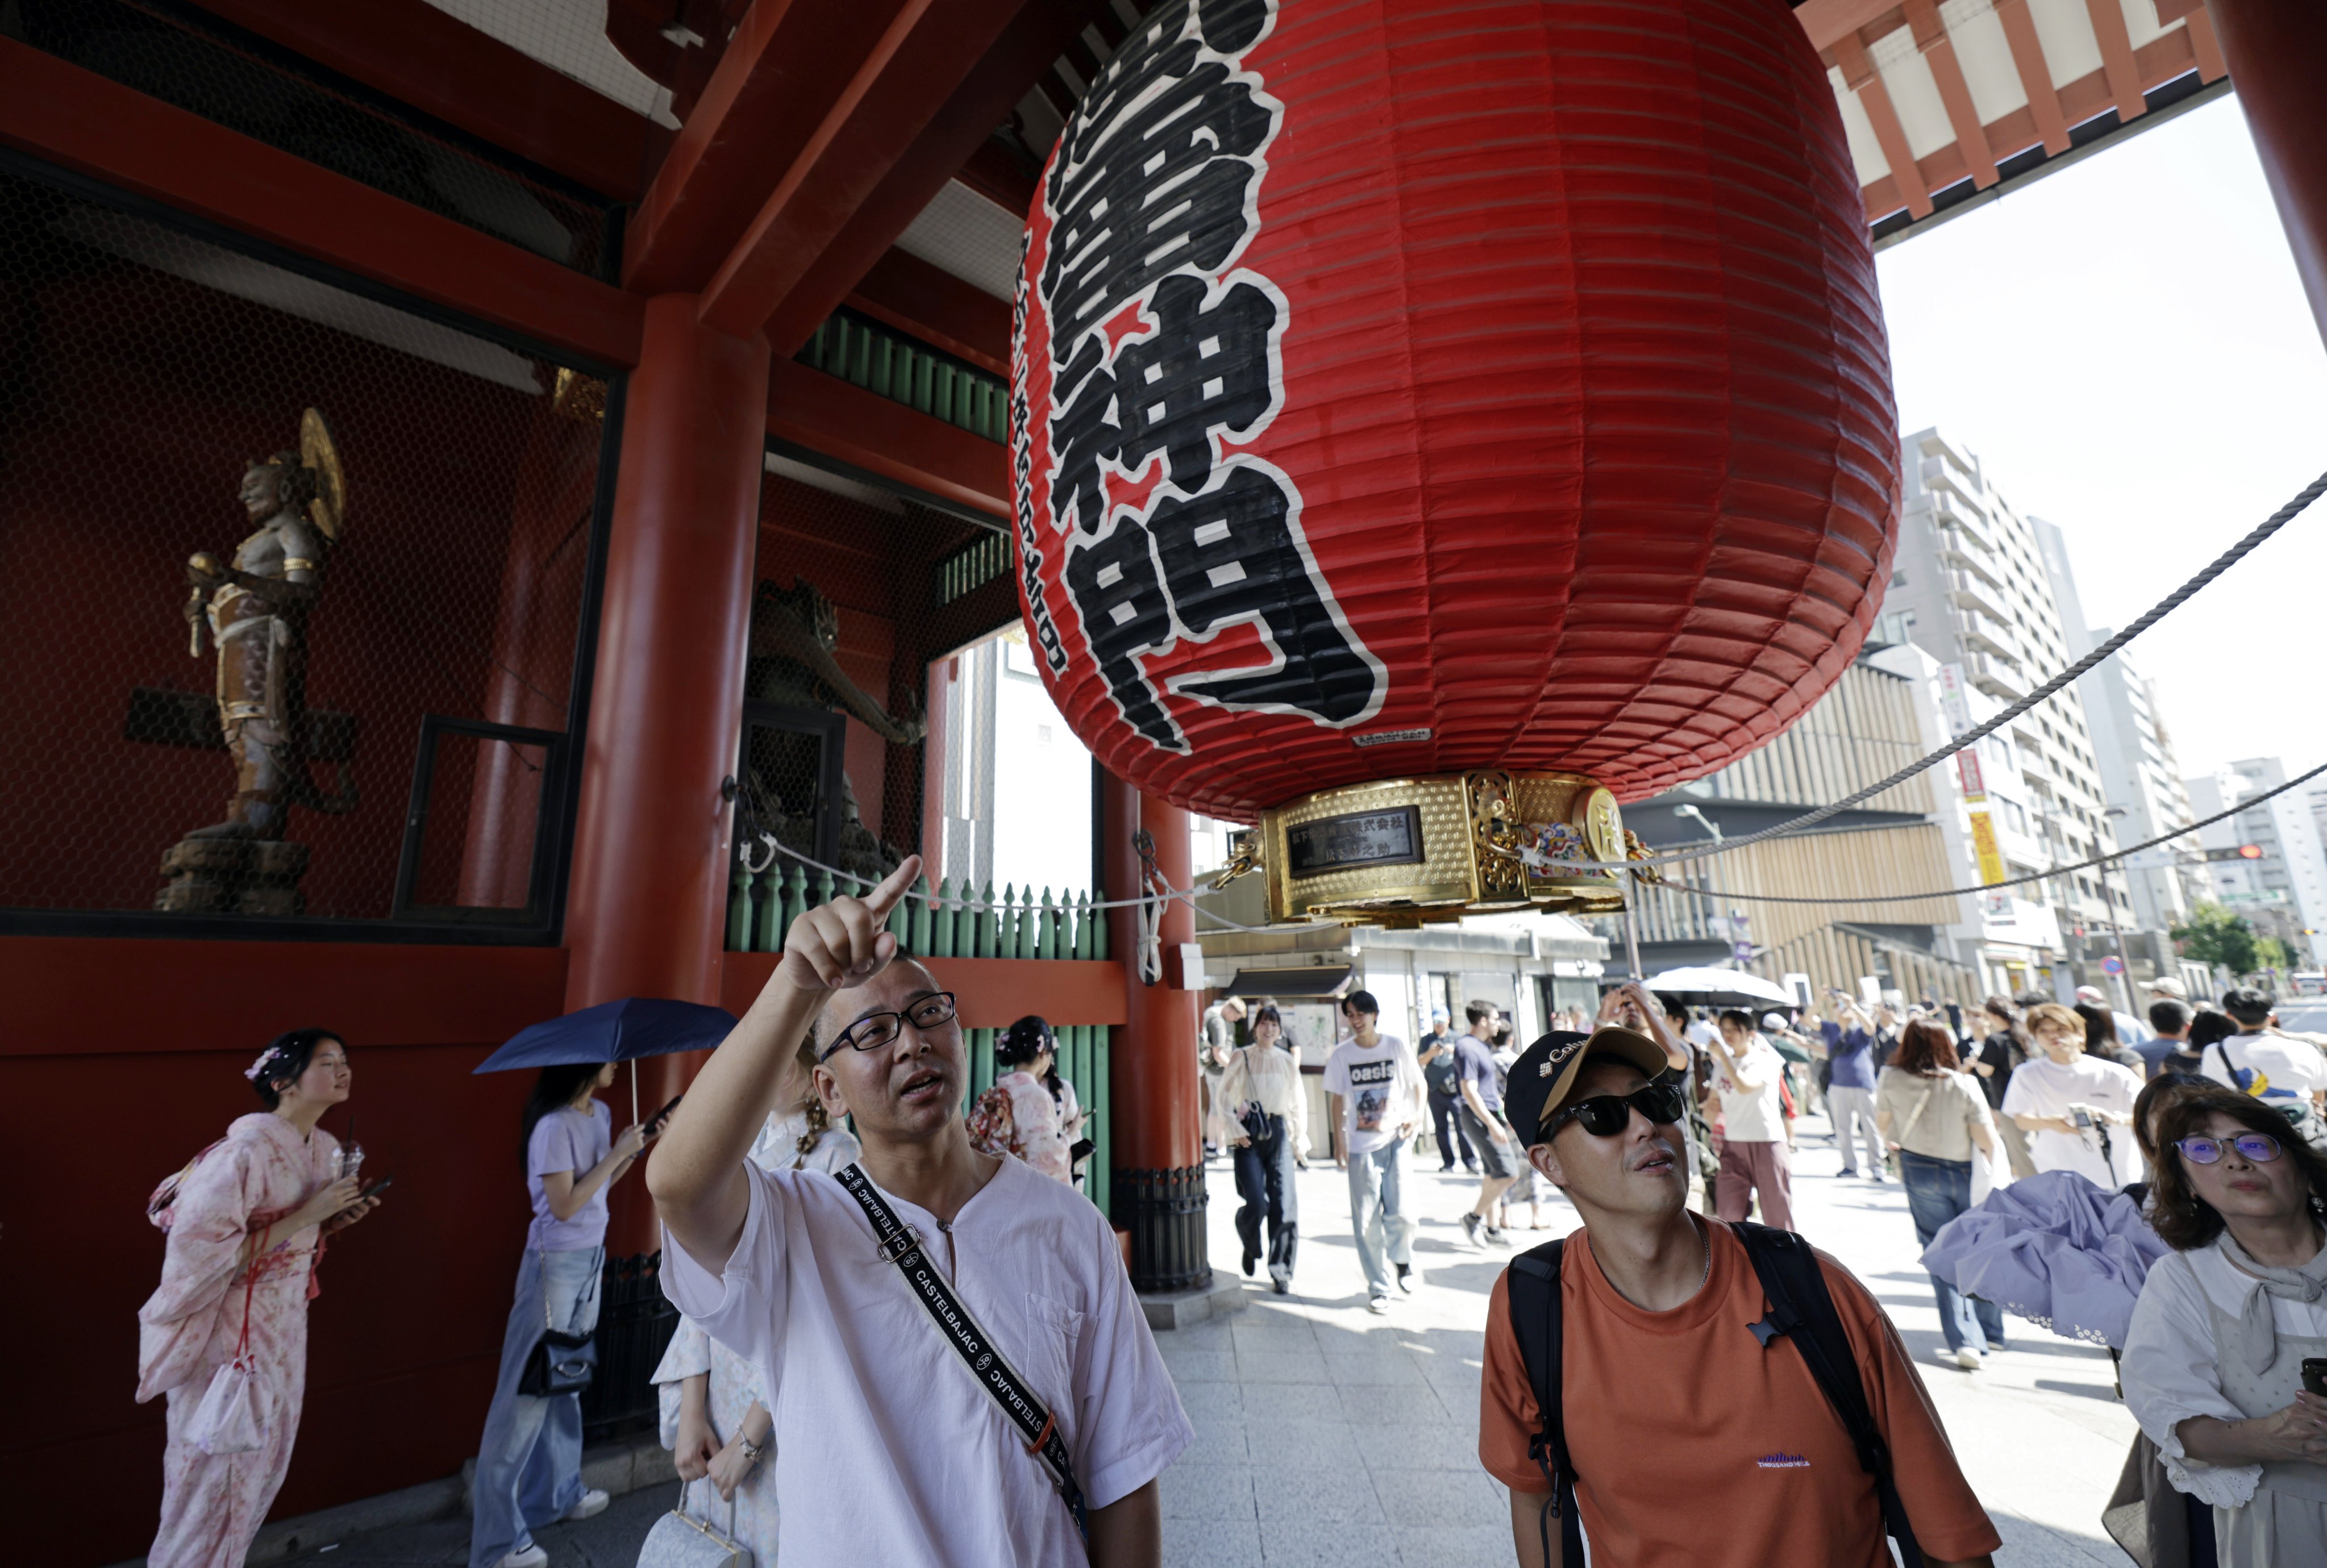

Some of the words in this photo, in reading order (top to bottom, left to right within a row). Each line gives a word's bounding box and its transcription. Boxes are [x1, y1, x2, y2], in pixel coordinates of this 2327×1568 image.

[1351, 1061, 1395, 1082] oasis
[858, 1188, 907, 1252] CATELBAJAC
[916, 1270, 978, 1353] CASTELBAJAC
